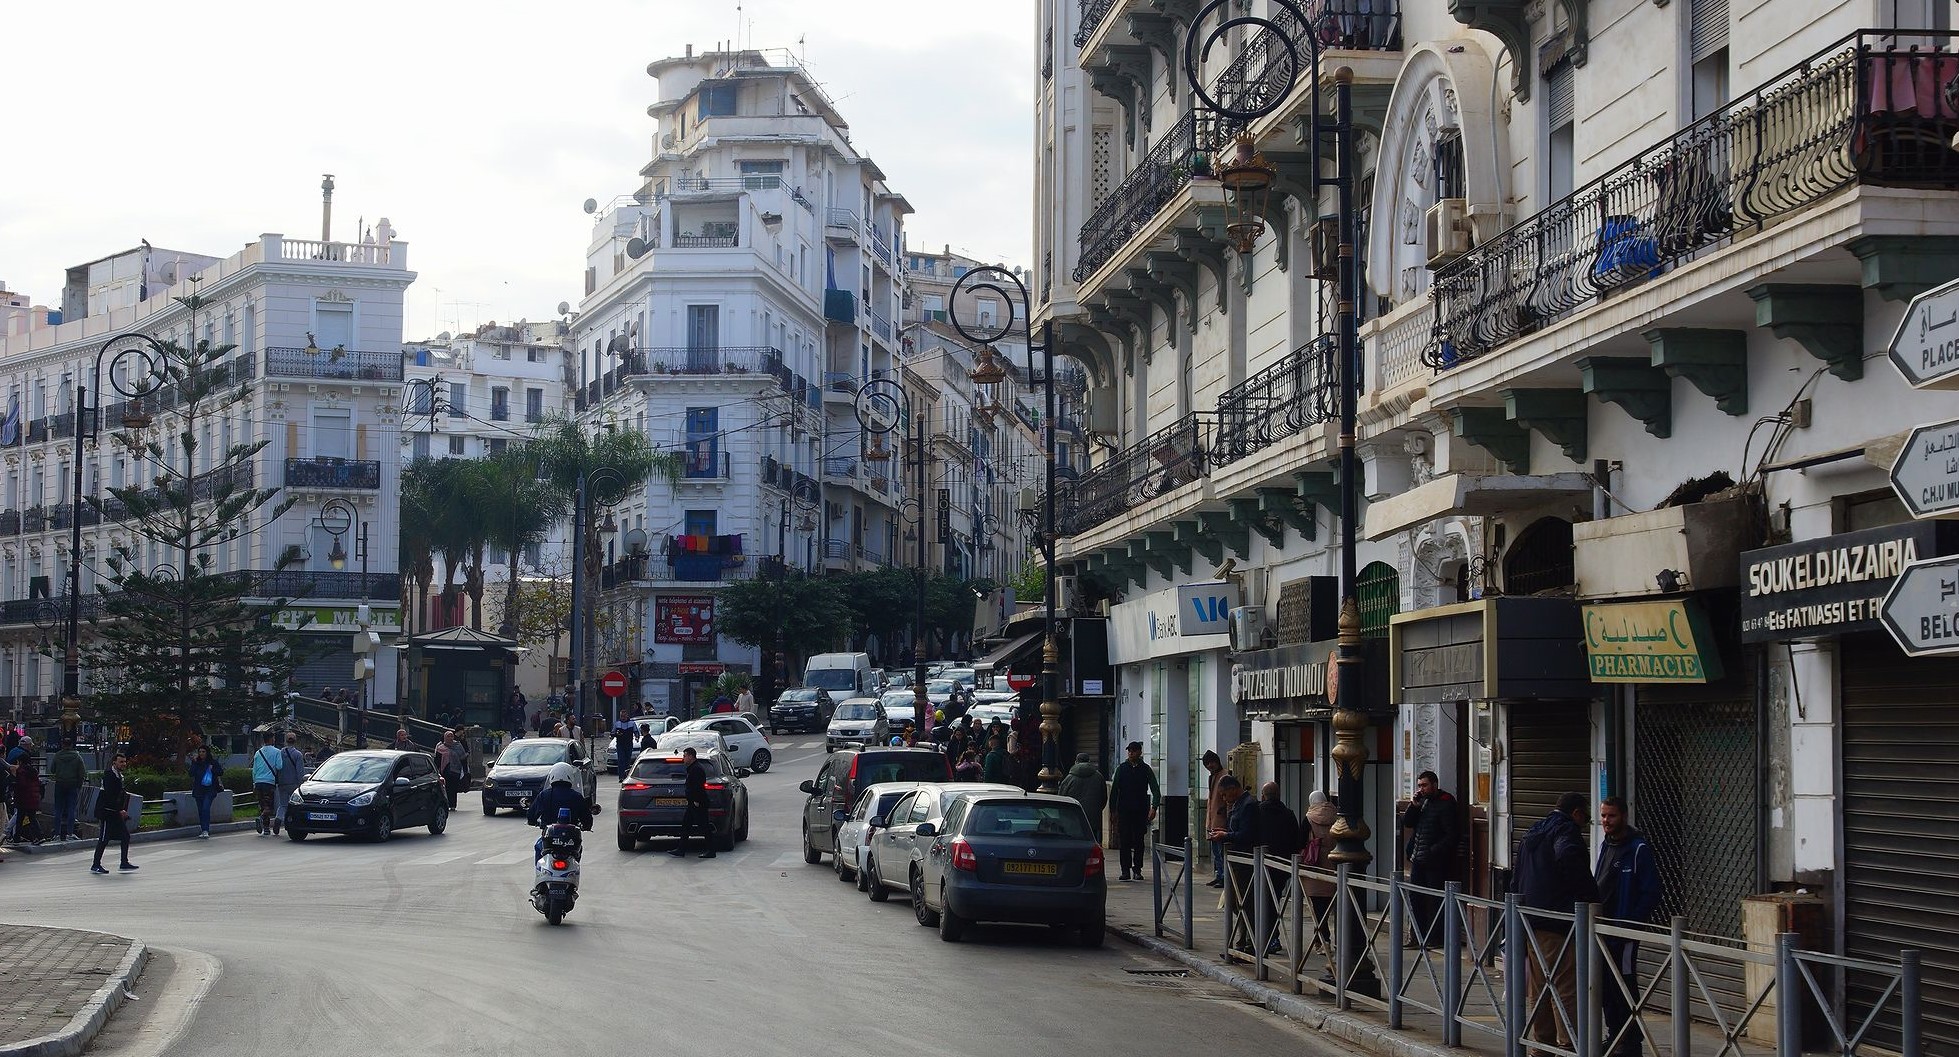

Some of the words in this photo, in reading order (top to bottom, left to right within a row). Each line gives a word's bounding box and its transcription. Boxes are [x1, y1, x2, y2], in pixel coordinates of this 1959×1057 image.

[1922, 338, 1959, 370] PLACE
[939, 490, 949, 538] HOTEL
[1769, 611, 1787, 631] Ets
[1787, 602, 1845, 629] FATNASSI
[1849, 600, 1865, 621] ET
[1599, 616, 1668, 651] صيدلية
[1242, 668, 1279, 700] PIZZERIA
[1284, 663, 1325, 698] NOUNOU
[1594, 655, 1698, 677] PHARMACIE
